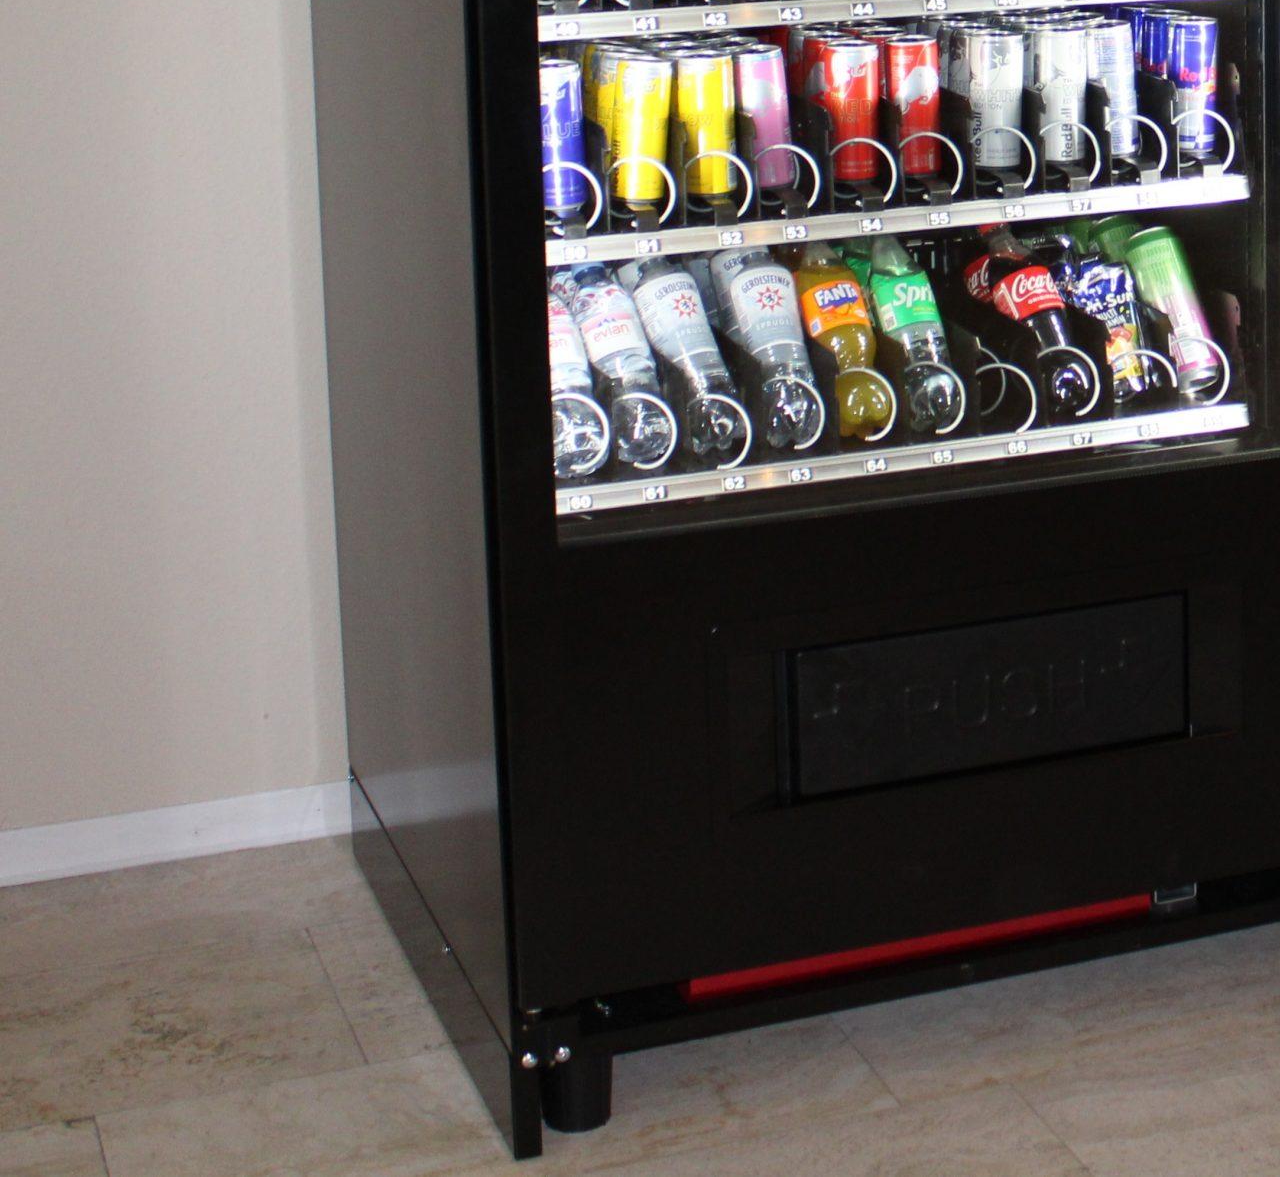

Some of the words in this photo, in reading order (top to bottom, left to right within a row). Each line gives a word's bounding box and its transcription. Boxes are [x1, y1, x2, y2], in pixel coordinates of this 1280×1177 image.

[853, 4, 874, 15] 44
[926, 0, 947, 11] 45
[705, 13, 727, 25] 42
[781, 8, 802, 20] 43
[636, 17, 658, 29] 41
[1004, 205, 1024, 216] 56
[1072, 200, 1091, 211] 57
[931, 213, 950, 225] 55
[862, 220, 882, 232] 54
[722, 233, 743, 245] 52
[786, 227, 807, 239] 53
[593, 322, 630, 342] evian
[1073, 434, 1092, 445] 67
[1008, 441, 1028, 454] 66
[934, 452, 953, 463] 65
[867, 459, 887, 471] 64
[791, 469, 812, 482] 63
[724, 478, 746, 490] 62
[646, 487, 667, 499] 61
